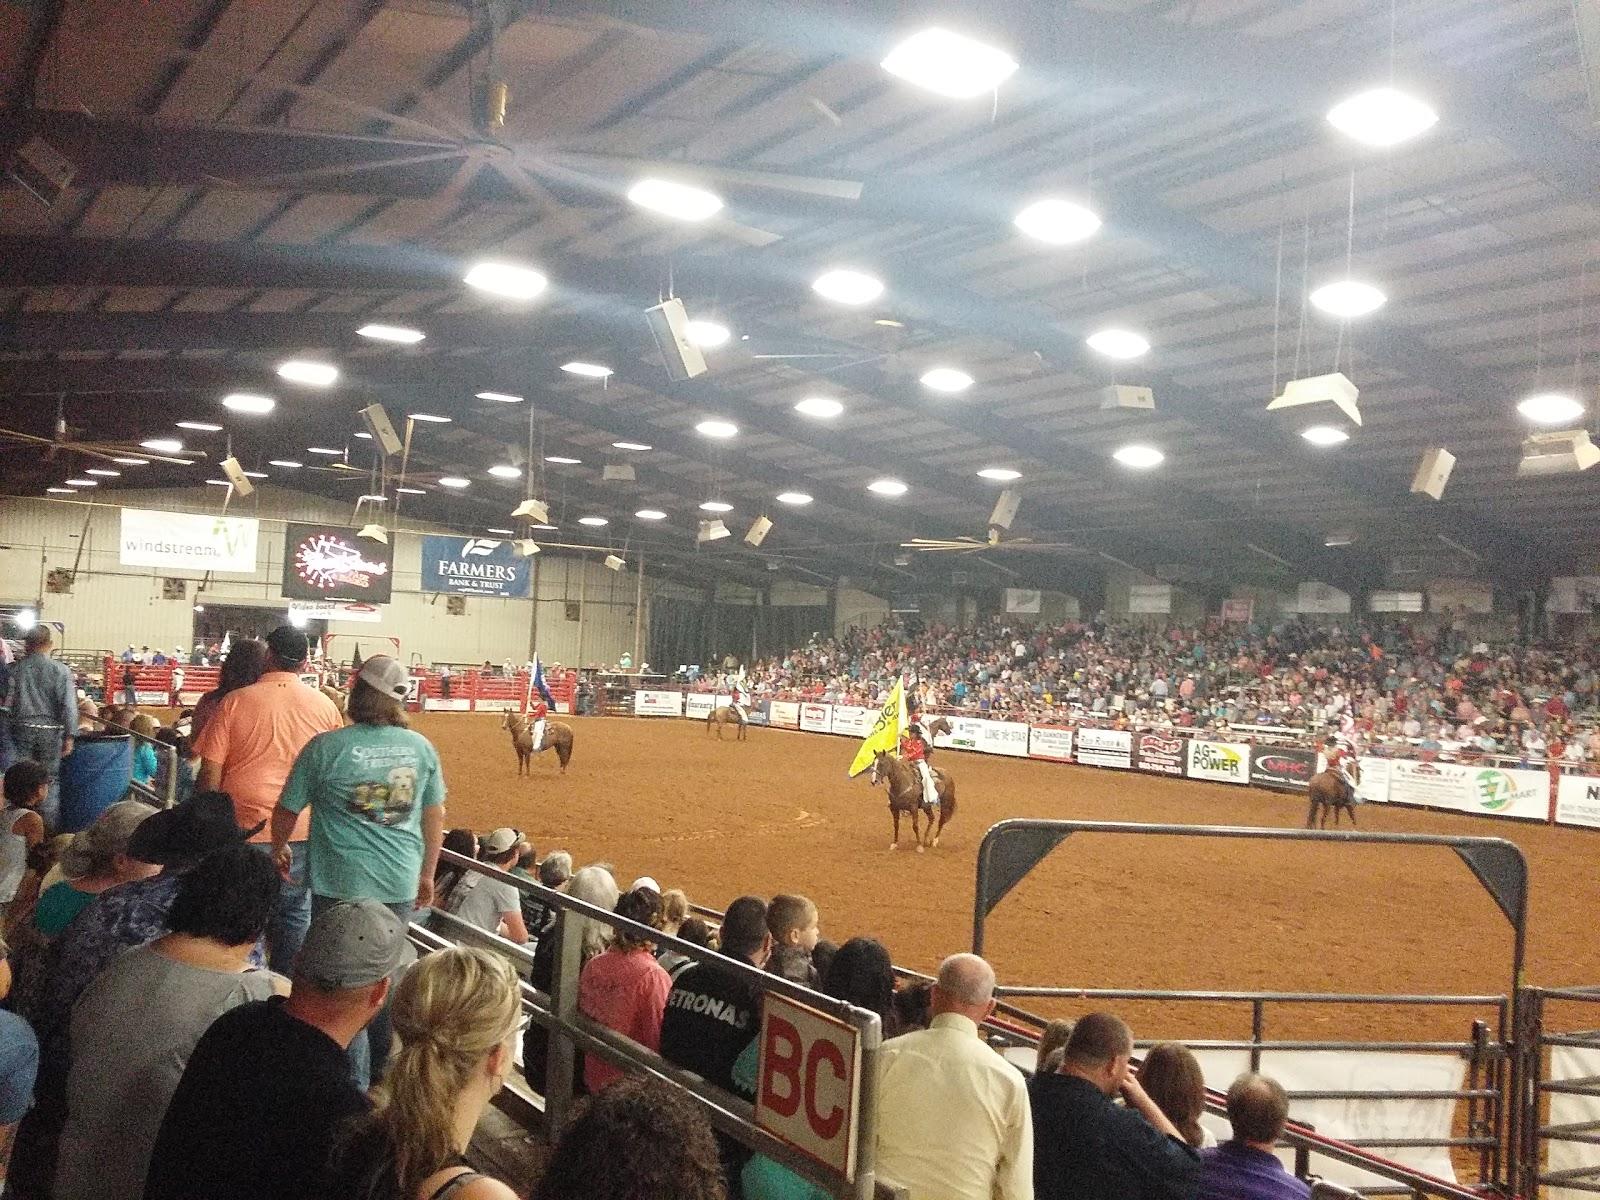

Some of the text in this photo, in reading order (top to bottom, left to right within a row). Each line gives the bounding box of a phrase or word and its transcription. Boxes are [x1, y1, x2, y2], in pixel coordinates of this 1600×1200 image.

[438, 560, 516, 581] FARMERS
[448, 578, 469, 587] BANK
[480, 581, 504, 590] TRUST
[1193, 743, 1217, 757] AG-
[1193, 757, 1239, 772] POWER
[1510, 788, 1538, 801] MART
[761, 1013, 847, 1141] BC
